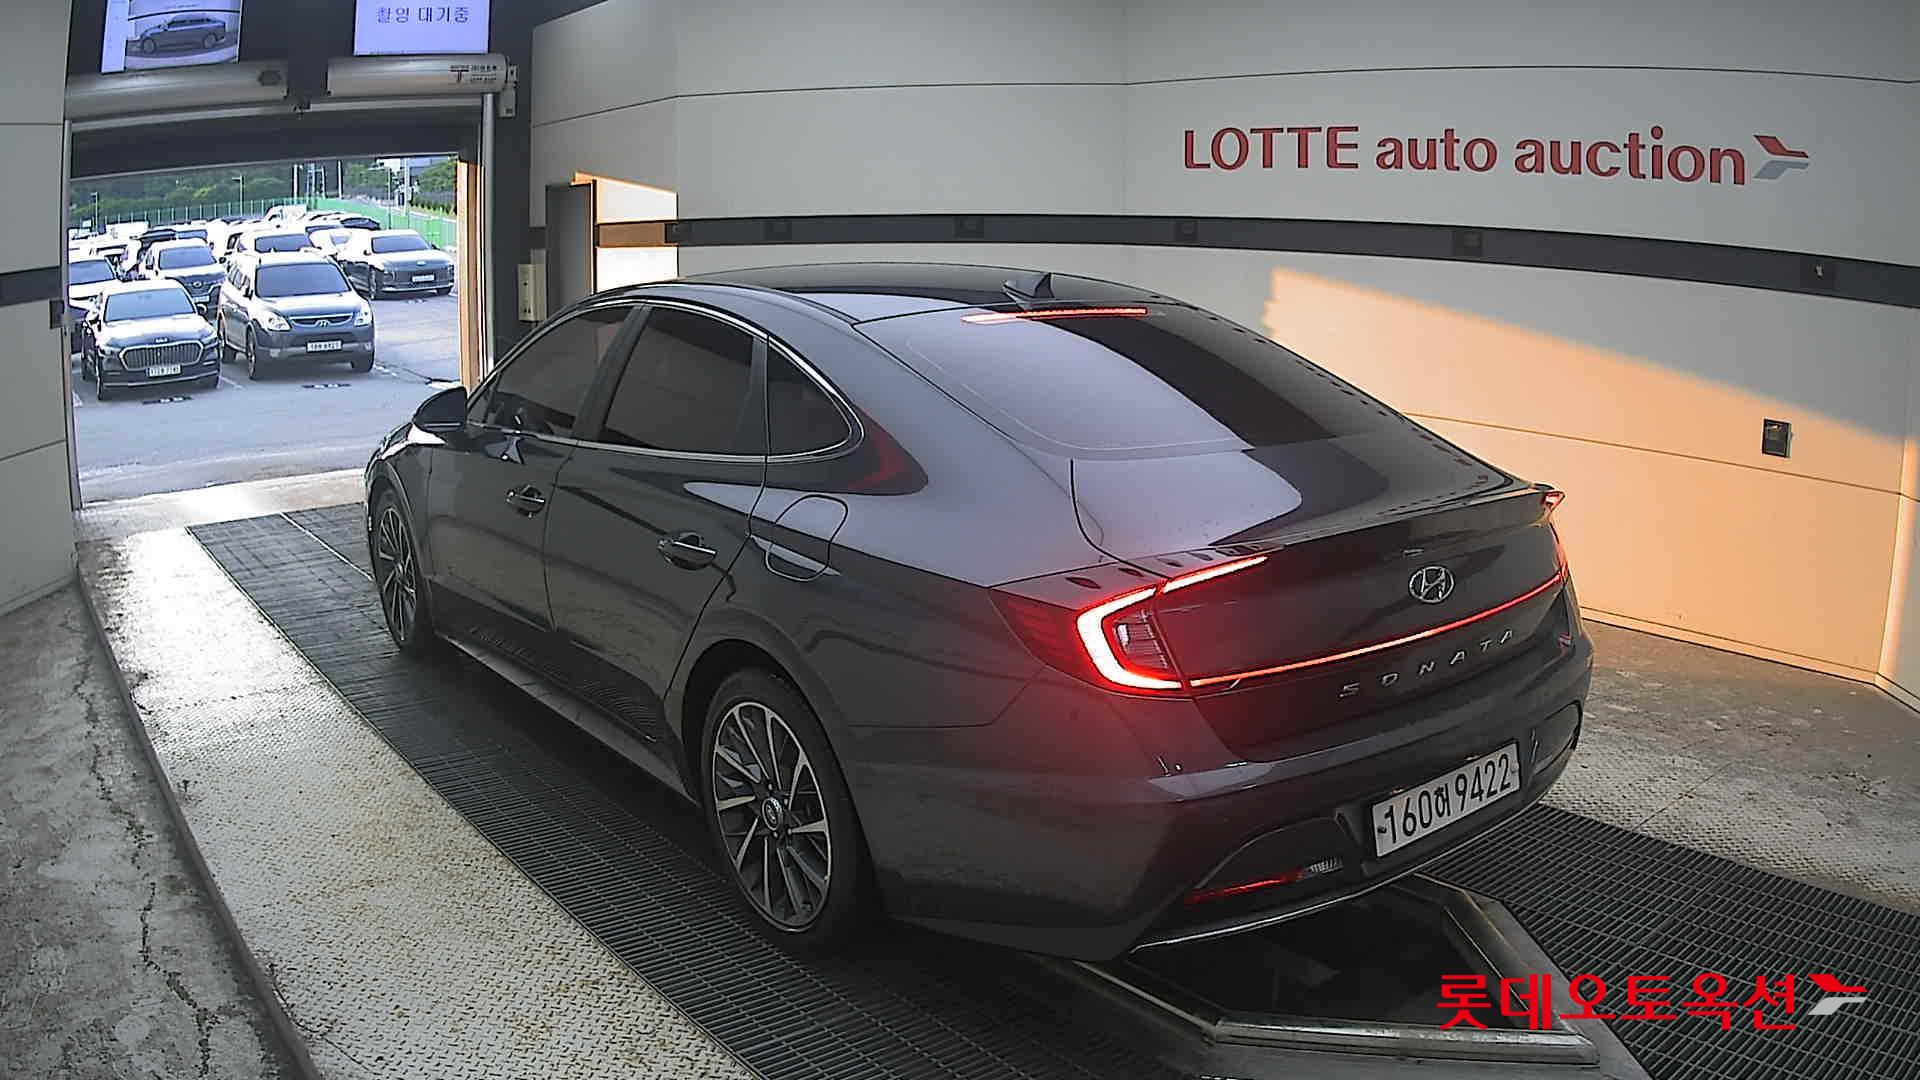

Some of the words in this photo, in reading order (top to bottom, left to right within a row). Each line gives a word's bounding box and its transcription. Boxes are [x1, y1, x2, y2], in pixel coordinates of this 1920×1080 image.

[1184, 126, 1359, 171] LOTTE
[1376, 129, 1497, 171] auto
[1514, 125, 1746, 186] auction
[1338, 629, 1514, 699] SONATA
